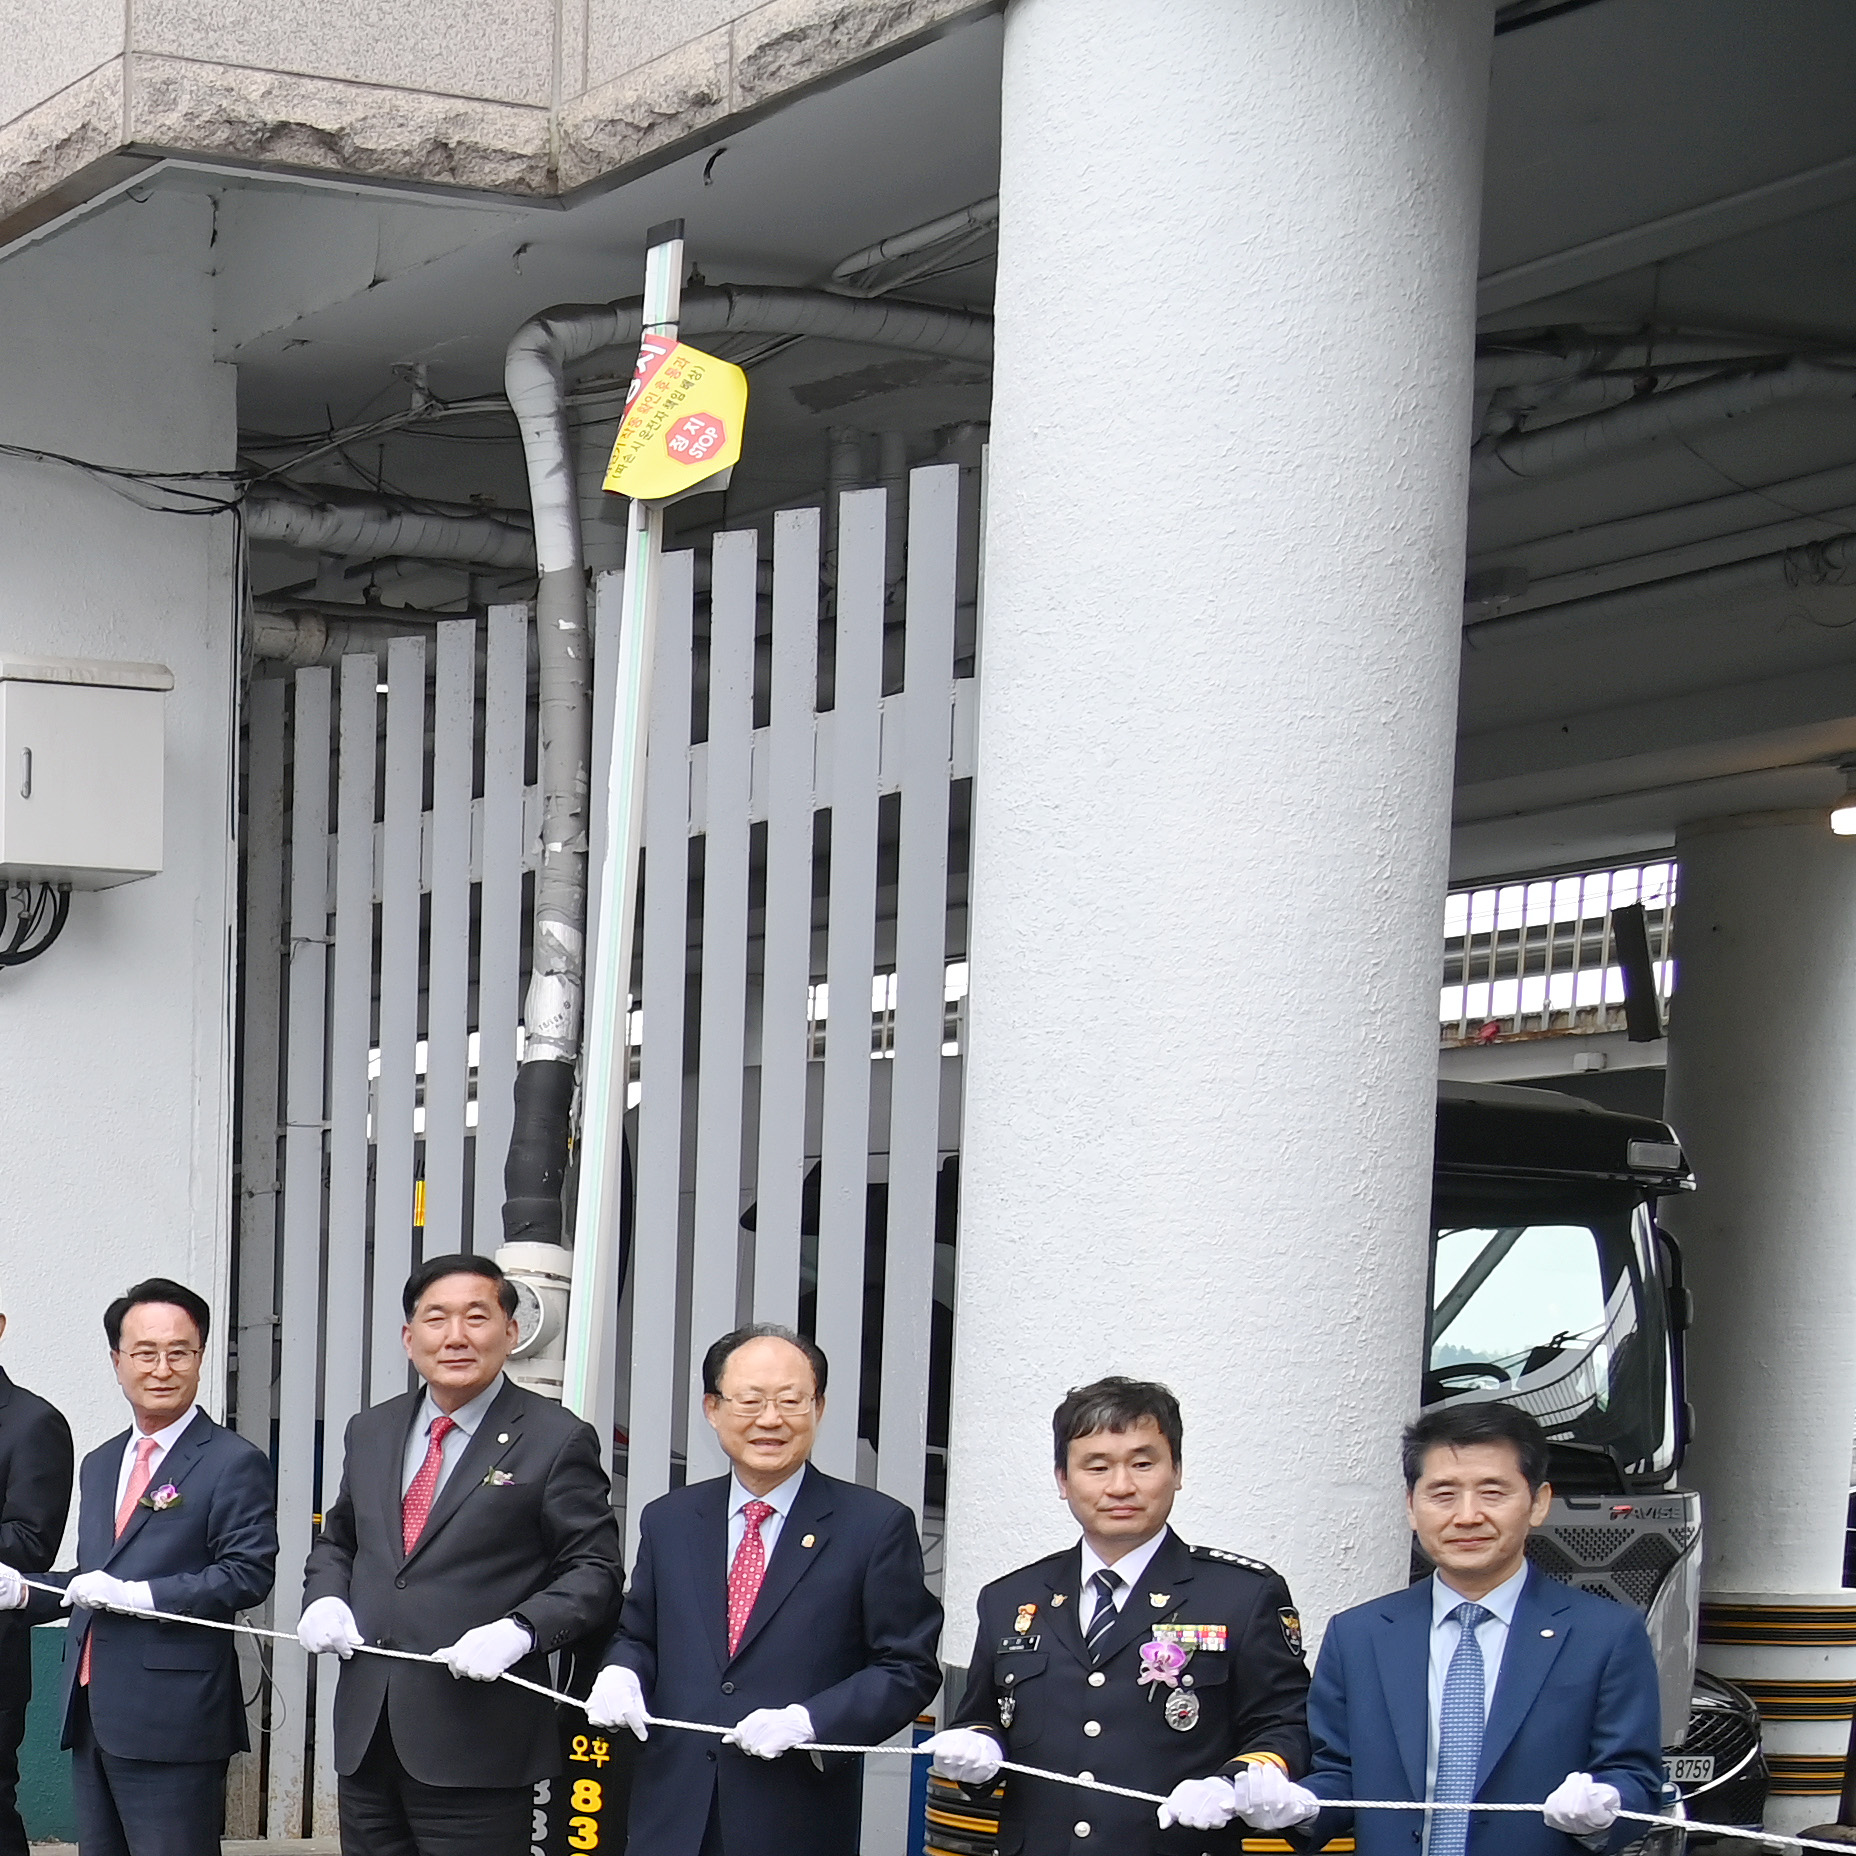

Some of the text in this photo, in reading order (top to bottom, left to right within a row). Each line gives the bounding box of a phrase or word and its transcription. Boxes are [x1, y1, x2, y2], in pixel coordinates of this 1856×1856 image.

[638, 410, 670, 441] 운전자
[688, 426, 719, 459] STOP
[1609, 1504, 1681, 1520] PAVISE
[1675, 1759, 1711, 1778] 8759
